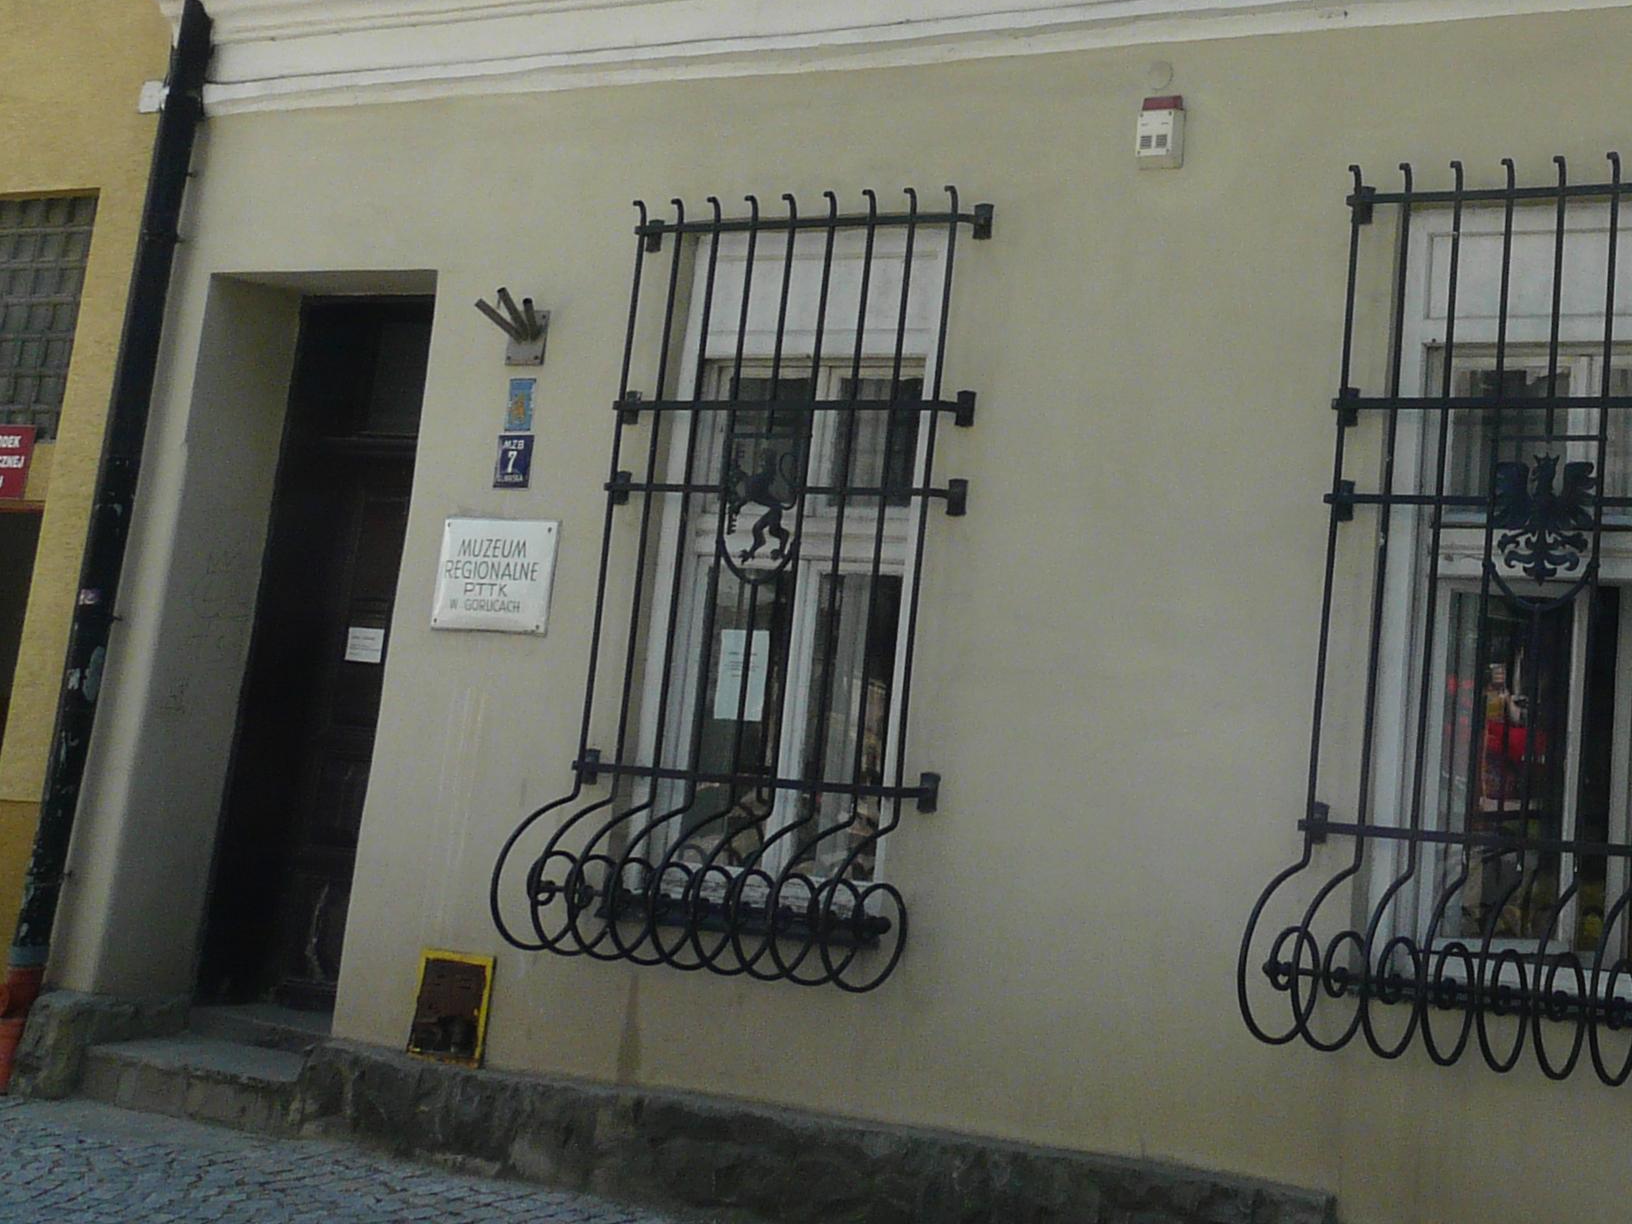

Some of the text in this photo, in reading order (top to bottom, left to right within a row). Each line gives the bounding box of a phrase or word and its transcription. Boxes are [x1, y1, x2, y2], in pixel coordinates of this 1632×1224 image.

[507, 450, 518, 473] 7
[457, 538, 527, 558] MUZEUM
[445, 560, 540, 582] REGIONALNE
[463, 582, 508, 597] PTTK
